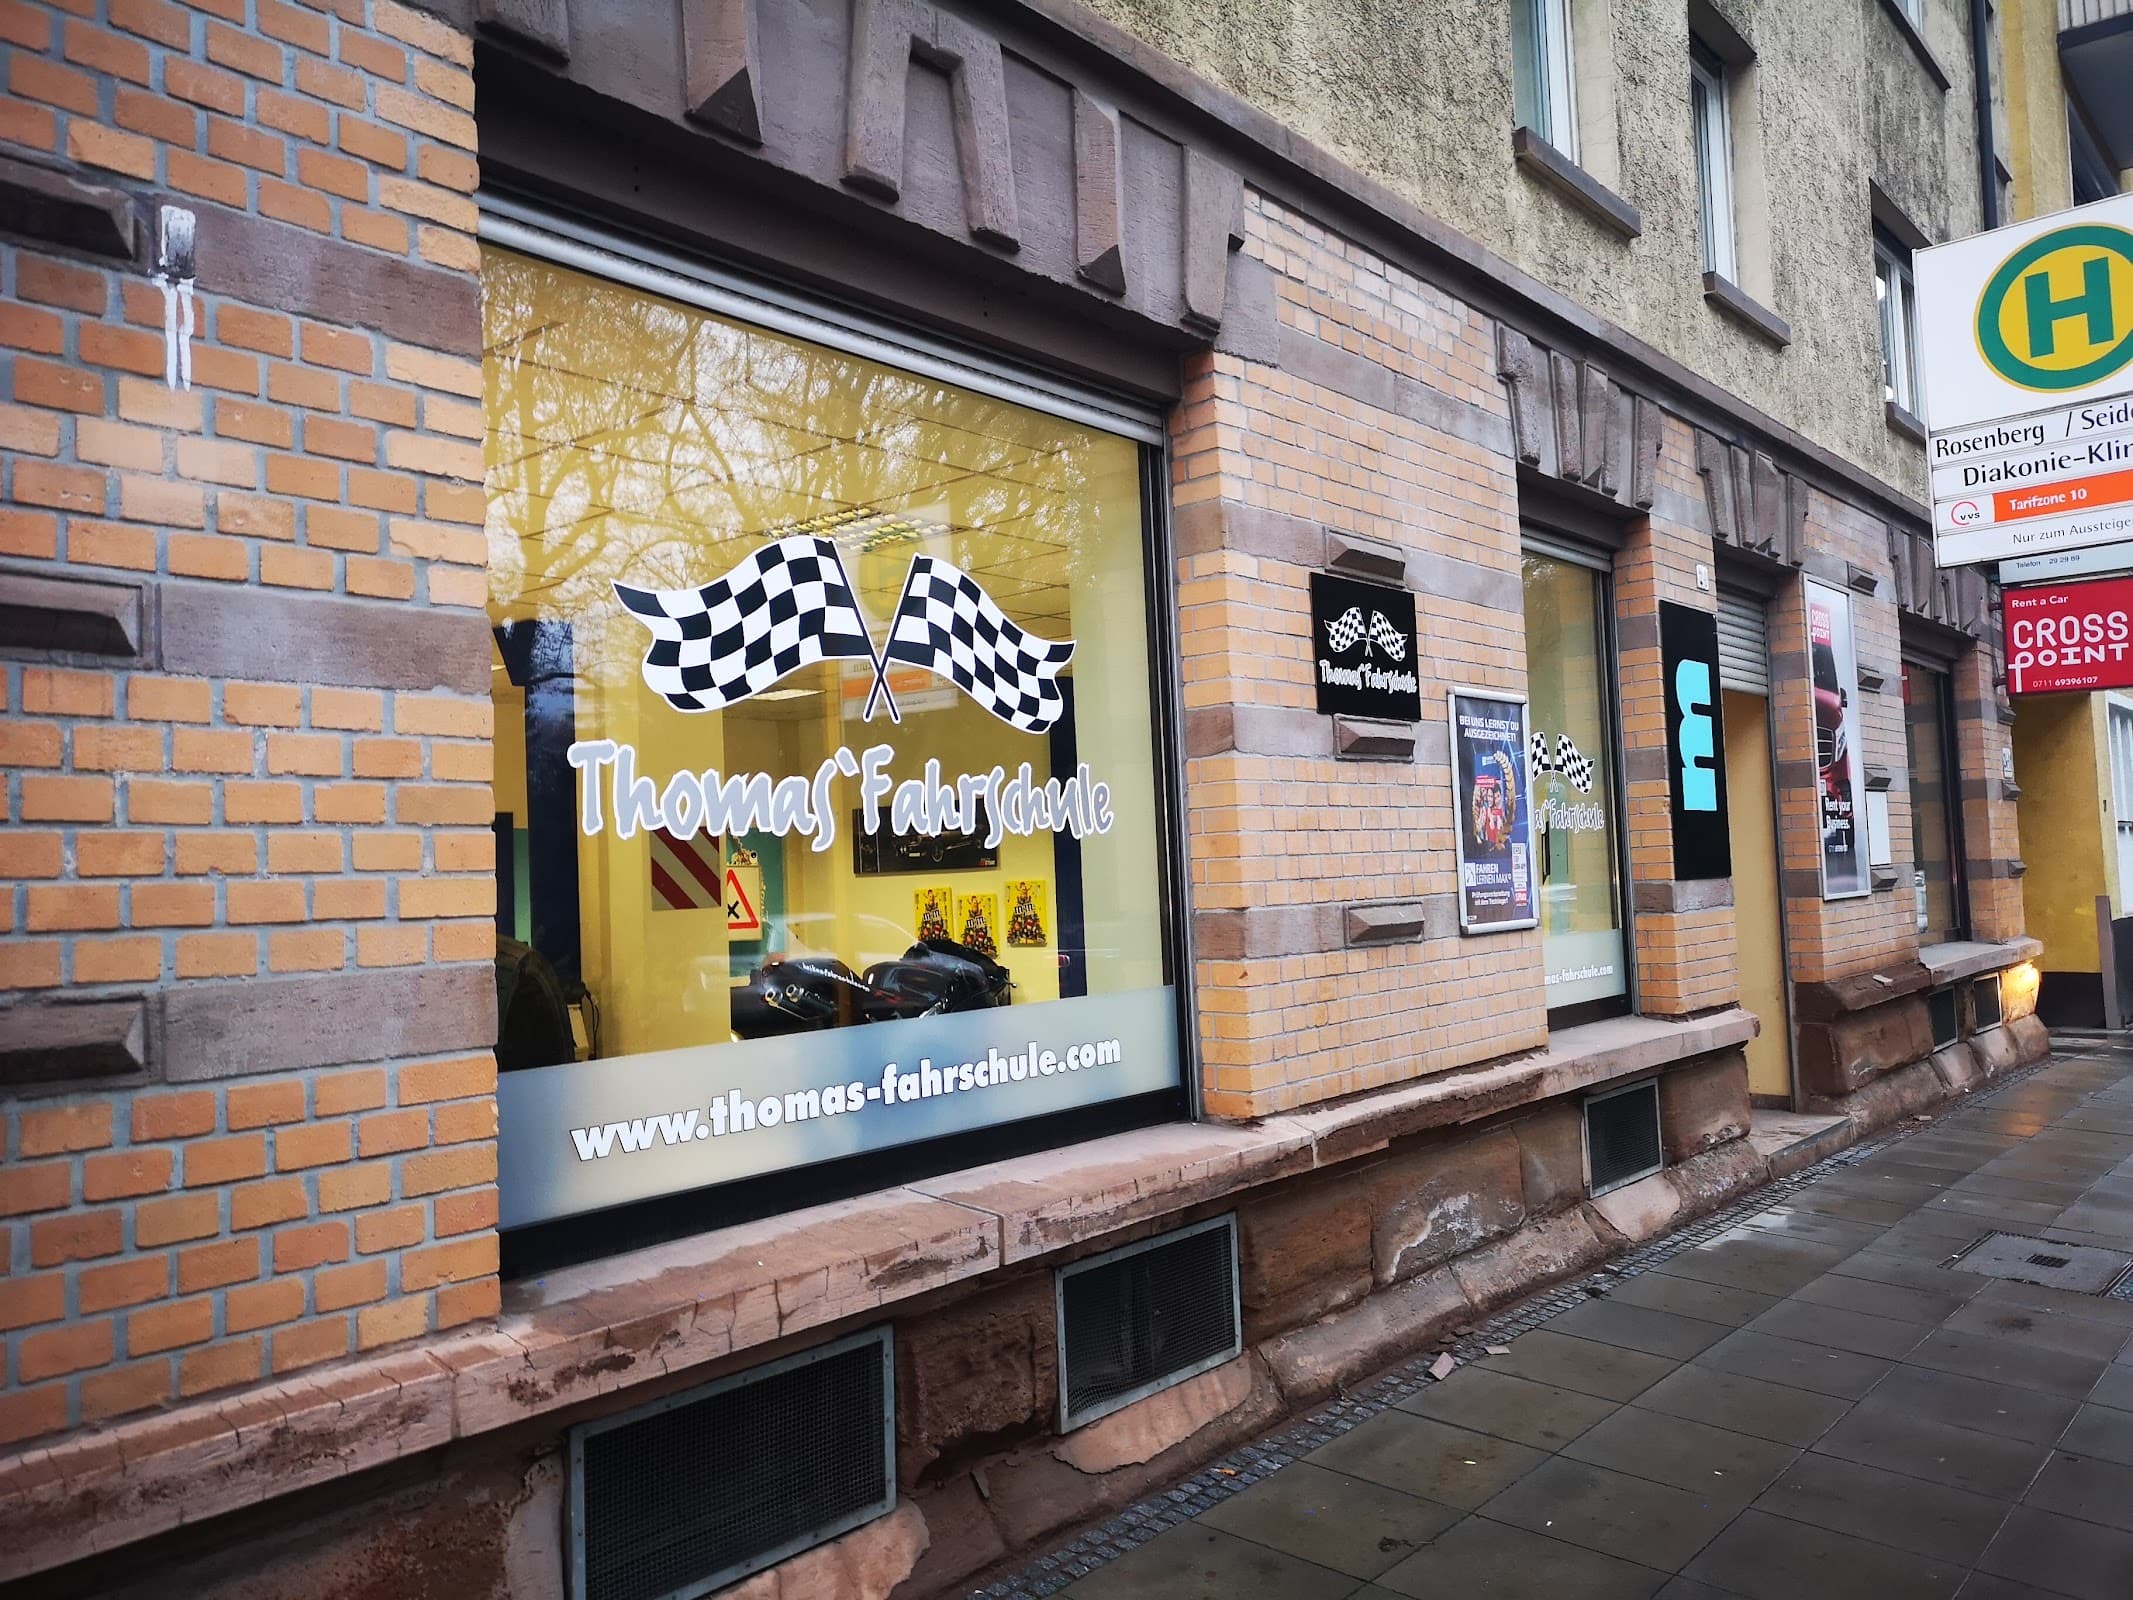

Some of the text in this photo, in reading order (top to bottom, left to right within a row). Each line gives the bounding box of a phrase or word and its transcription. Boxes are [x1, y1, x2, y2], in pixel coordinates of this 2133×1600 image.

[2024, 256, 2114, 359] H
[1936, 424, 2045, 458] Rosenberg
[2081, 402, 2133, 430] Seid
[2009, 492, 2066, 512] Tarifzone
[2070, 488, 2088, 501] 10
[2013, 533, 2035, 544] Nur
[2040, 528, 2065, 540] zum
[2011, 598, 2037, 608] Rent
[2049, 595, 2069, 604] Car
[2013, 611, 2128, 649] CROSS
[2008, 643, 2129, 693] POINT
[2054, 676, 2098, 687] 69396107
[1471, 717, 1485, 728] UNS
[1485, 718, 1509, 730] LERNST
[1511, 721, 1520, 731] DU
[862, 743, 1113, 850] Fahrschule
[1549, 798, 1605, 834] Fahrschule
[570, 1036, 1121, 1162] www.thomas-fahrschule.com
